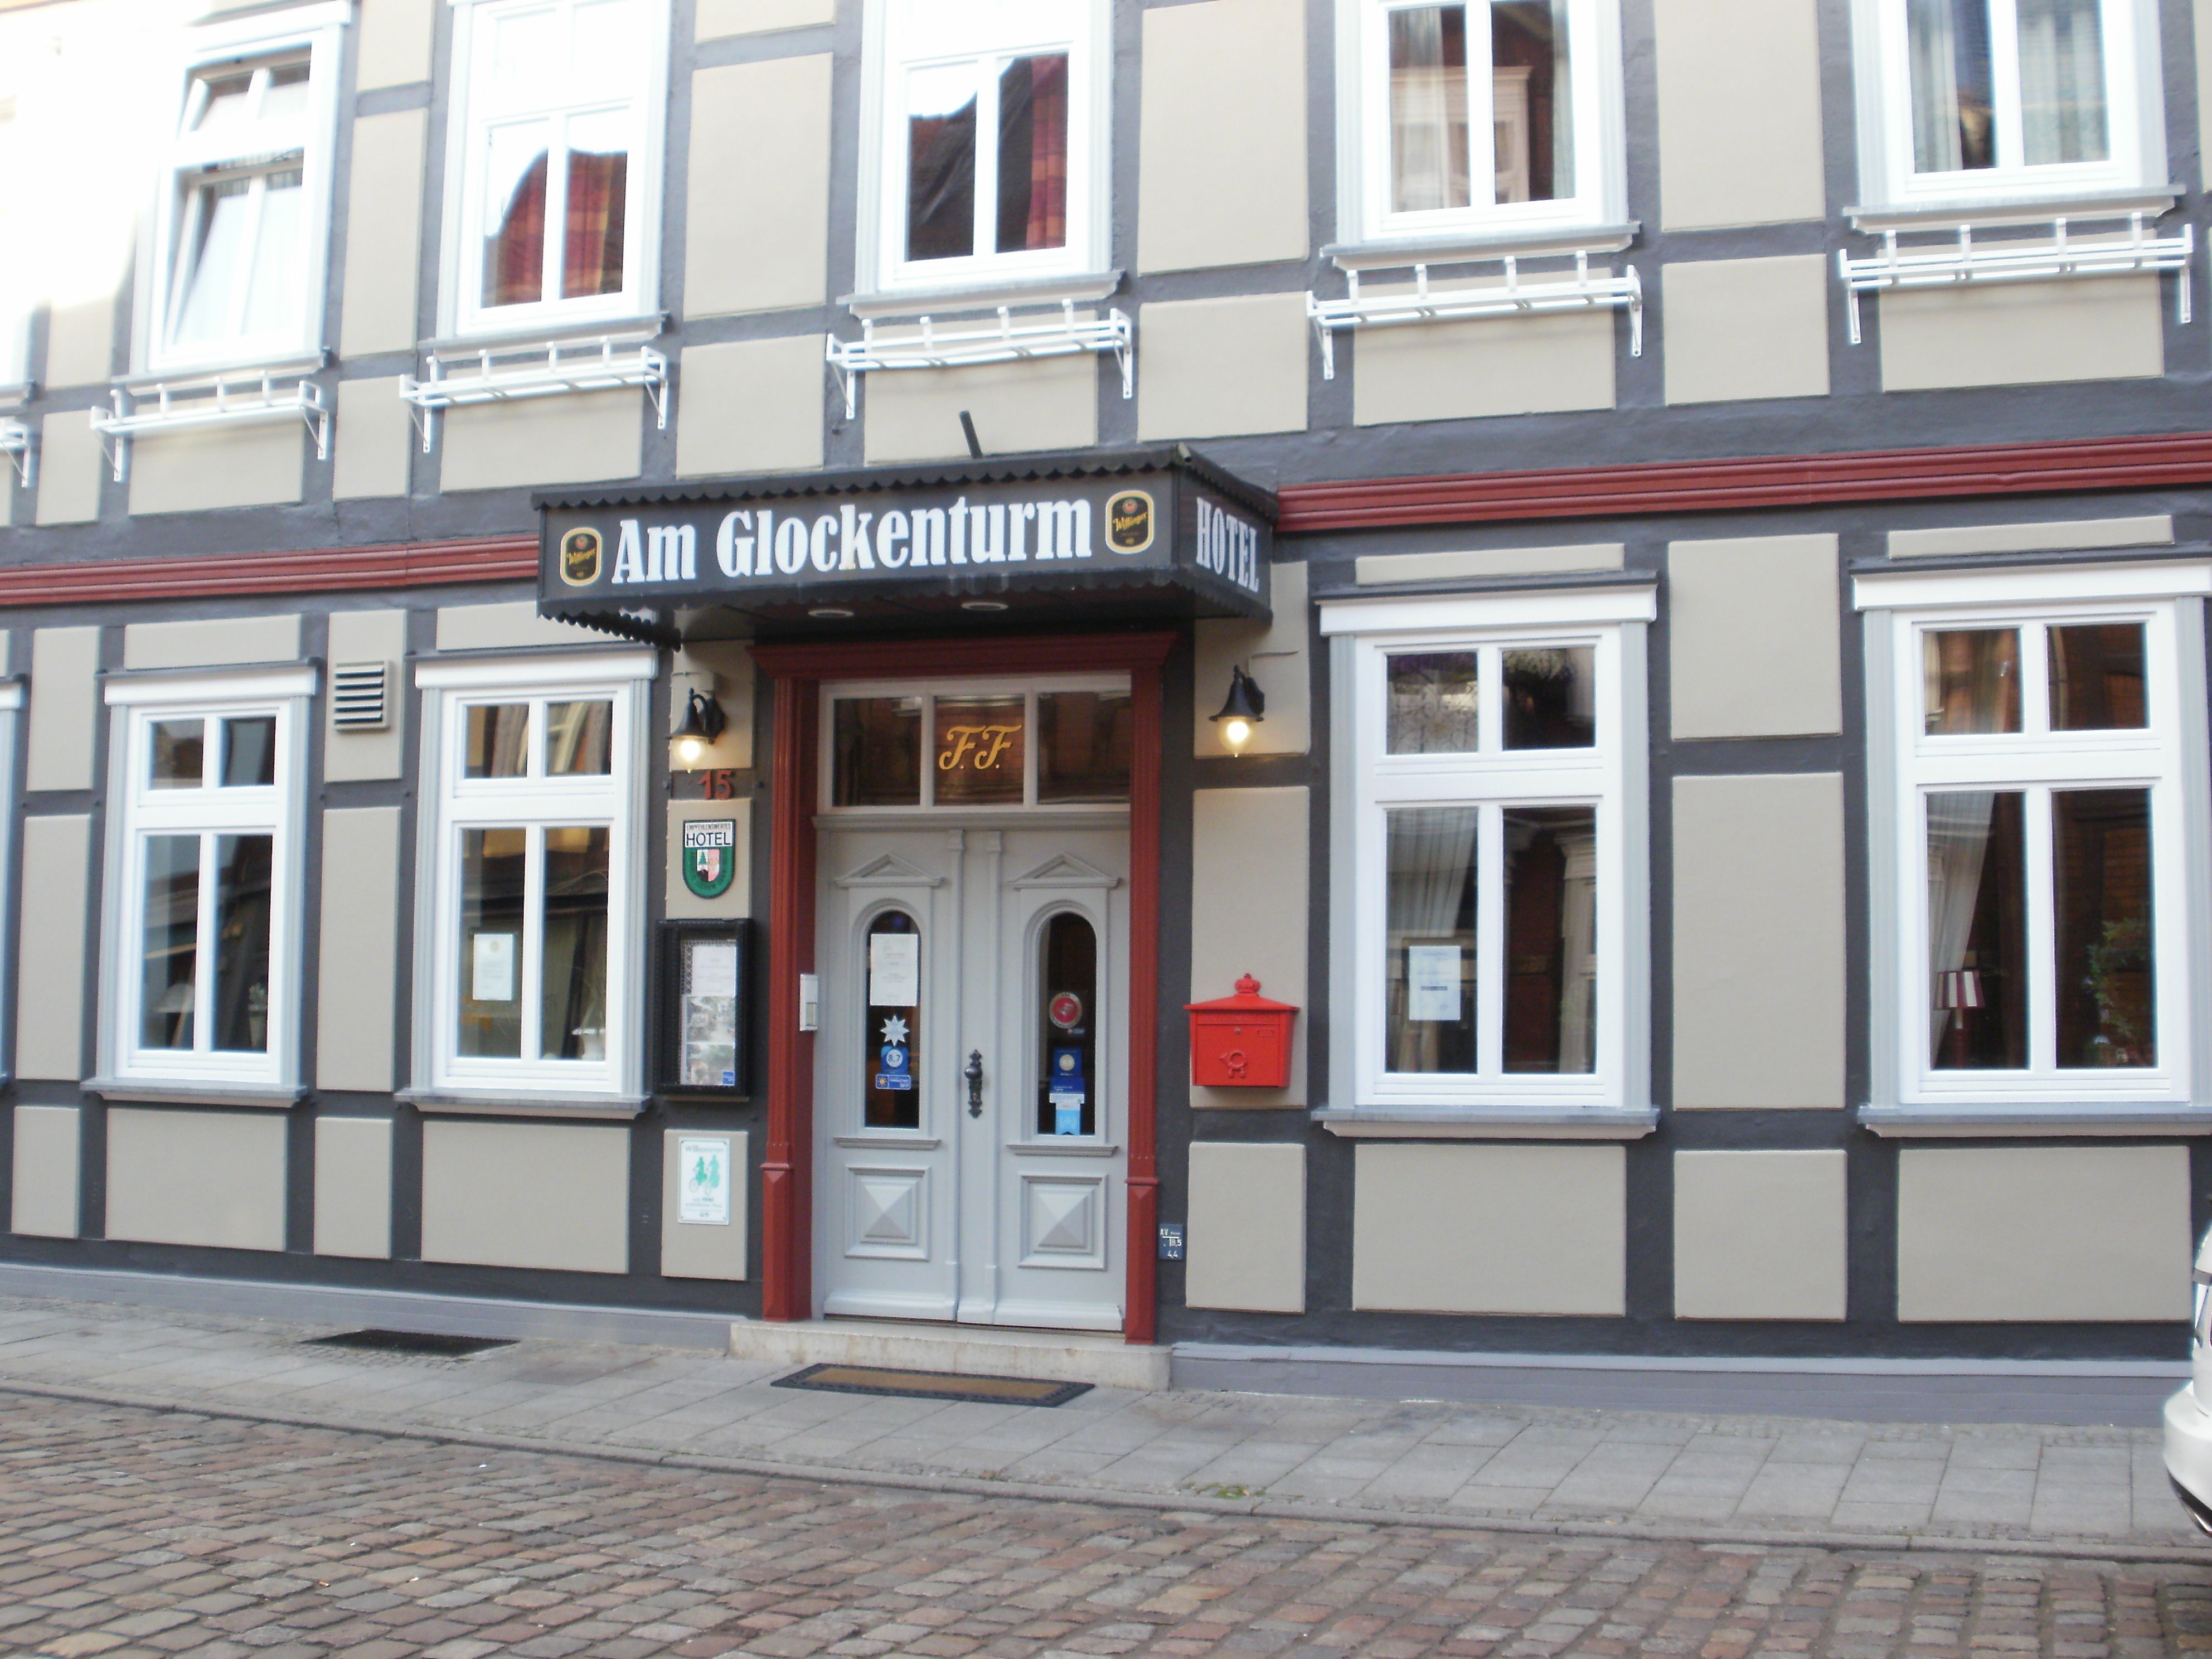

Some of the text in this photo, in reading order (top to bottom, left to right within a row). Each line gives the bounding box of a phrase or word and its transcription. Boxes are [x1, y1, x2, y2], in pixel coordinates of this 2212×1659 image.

[612, 496, 1092, 584] Am Glockenturm
[1196, 497, 1260, 594] HOTEL
[698, 770, 732, 800] 15
[686, 832, 731, 846] HOTEL
